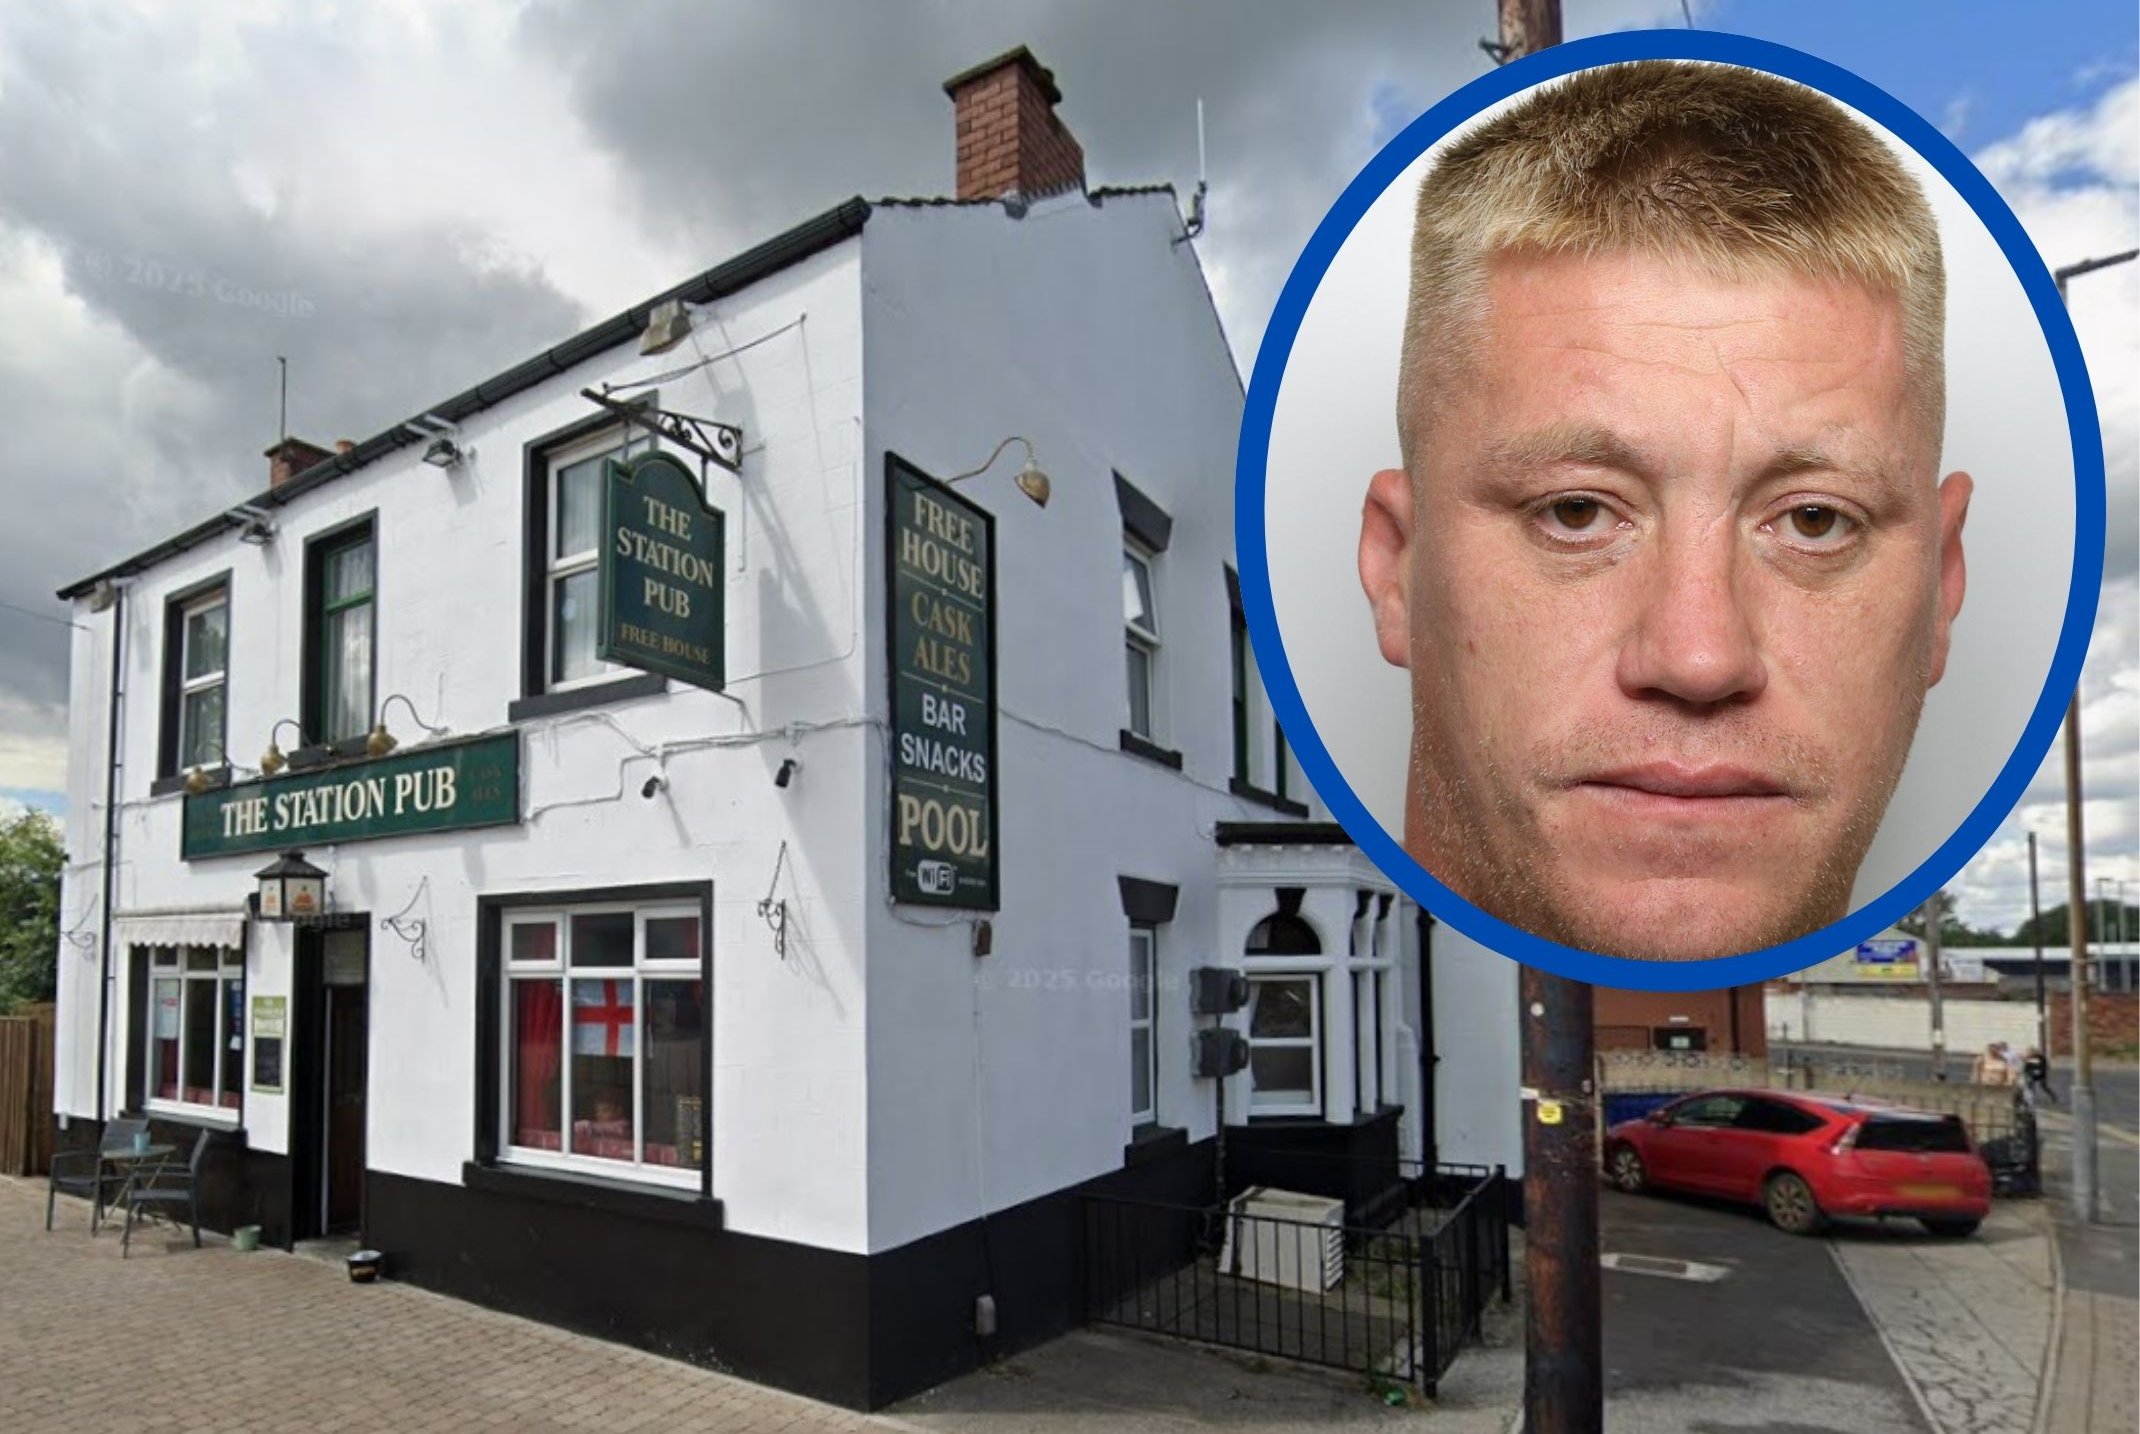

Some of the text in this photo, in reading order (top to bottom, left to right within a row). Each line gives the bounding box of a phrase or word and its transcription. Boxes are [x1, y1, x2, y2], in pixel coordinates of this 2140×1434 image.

[643, 496, 692, 541] THE
[913, 491, 974, 555] FREE
[617, 526, 714, 589] STATION
[902, 527, 983, 599] HOUSE
[643, 576, 691, 619] PUB
[912, 591, 973, 646] CASK
[620, 622, 711, 665] FREE HOUSE
[913, 636, 971, 685] ALES
[922, 693, 967, 736] BAR
[901, 732, 985, 784] SNACKS
[220, 798, 268, 838] THE
[273, 776, 386, 830] STATION
[394, 766, 457, 815] PUB
[899, 793, 988, 857] POOL
